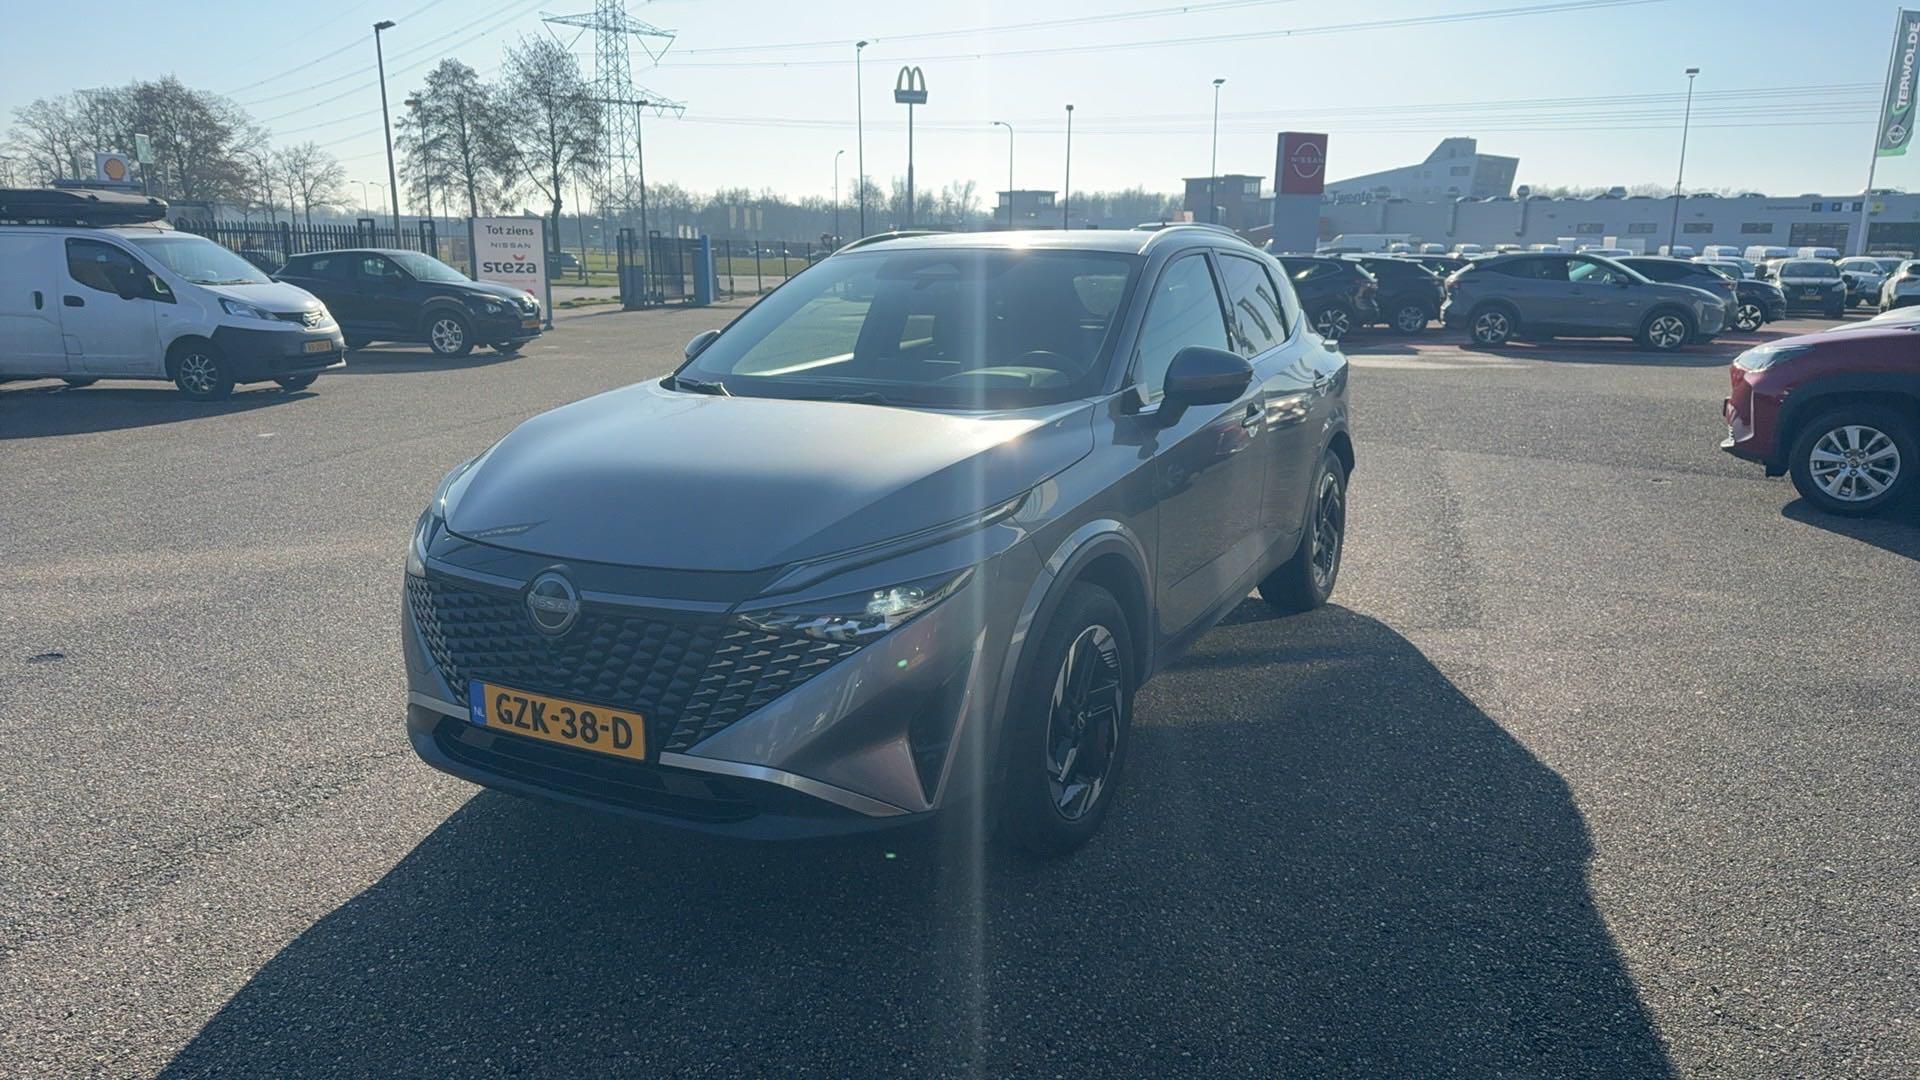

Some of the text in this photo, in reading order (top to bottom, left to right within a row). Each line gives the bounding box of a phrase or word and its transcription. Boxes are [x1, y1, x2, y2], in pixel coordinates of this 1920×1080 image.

[1896, 22, 1920, 108] TERWOLDE
[1291, 156, 1324, 164] NISSAN
[486, 225, 534, 236] Tot ziens
[473, 705, 485, 718] NL
[495, 693, 633, 749] GZK-38-D
